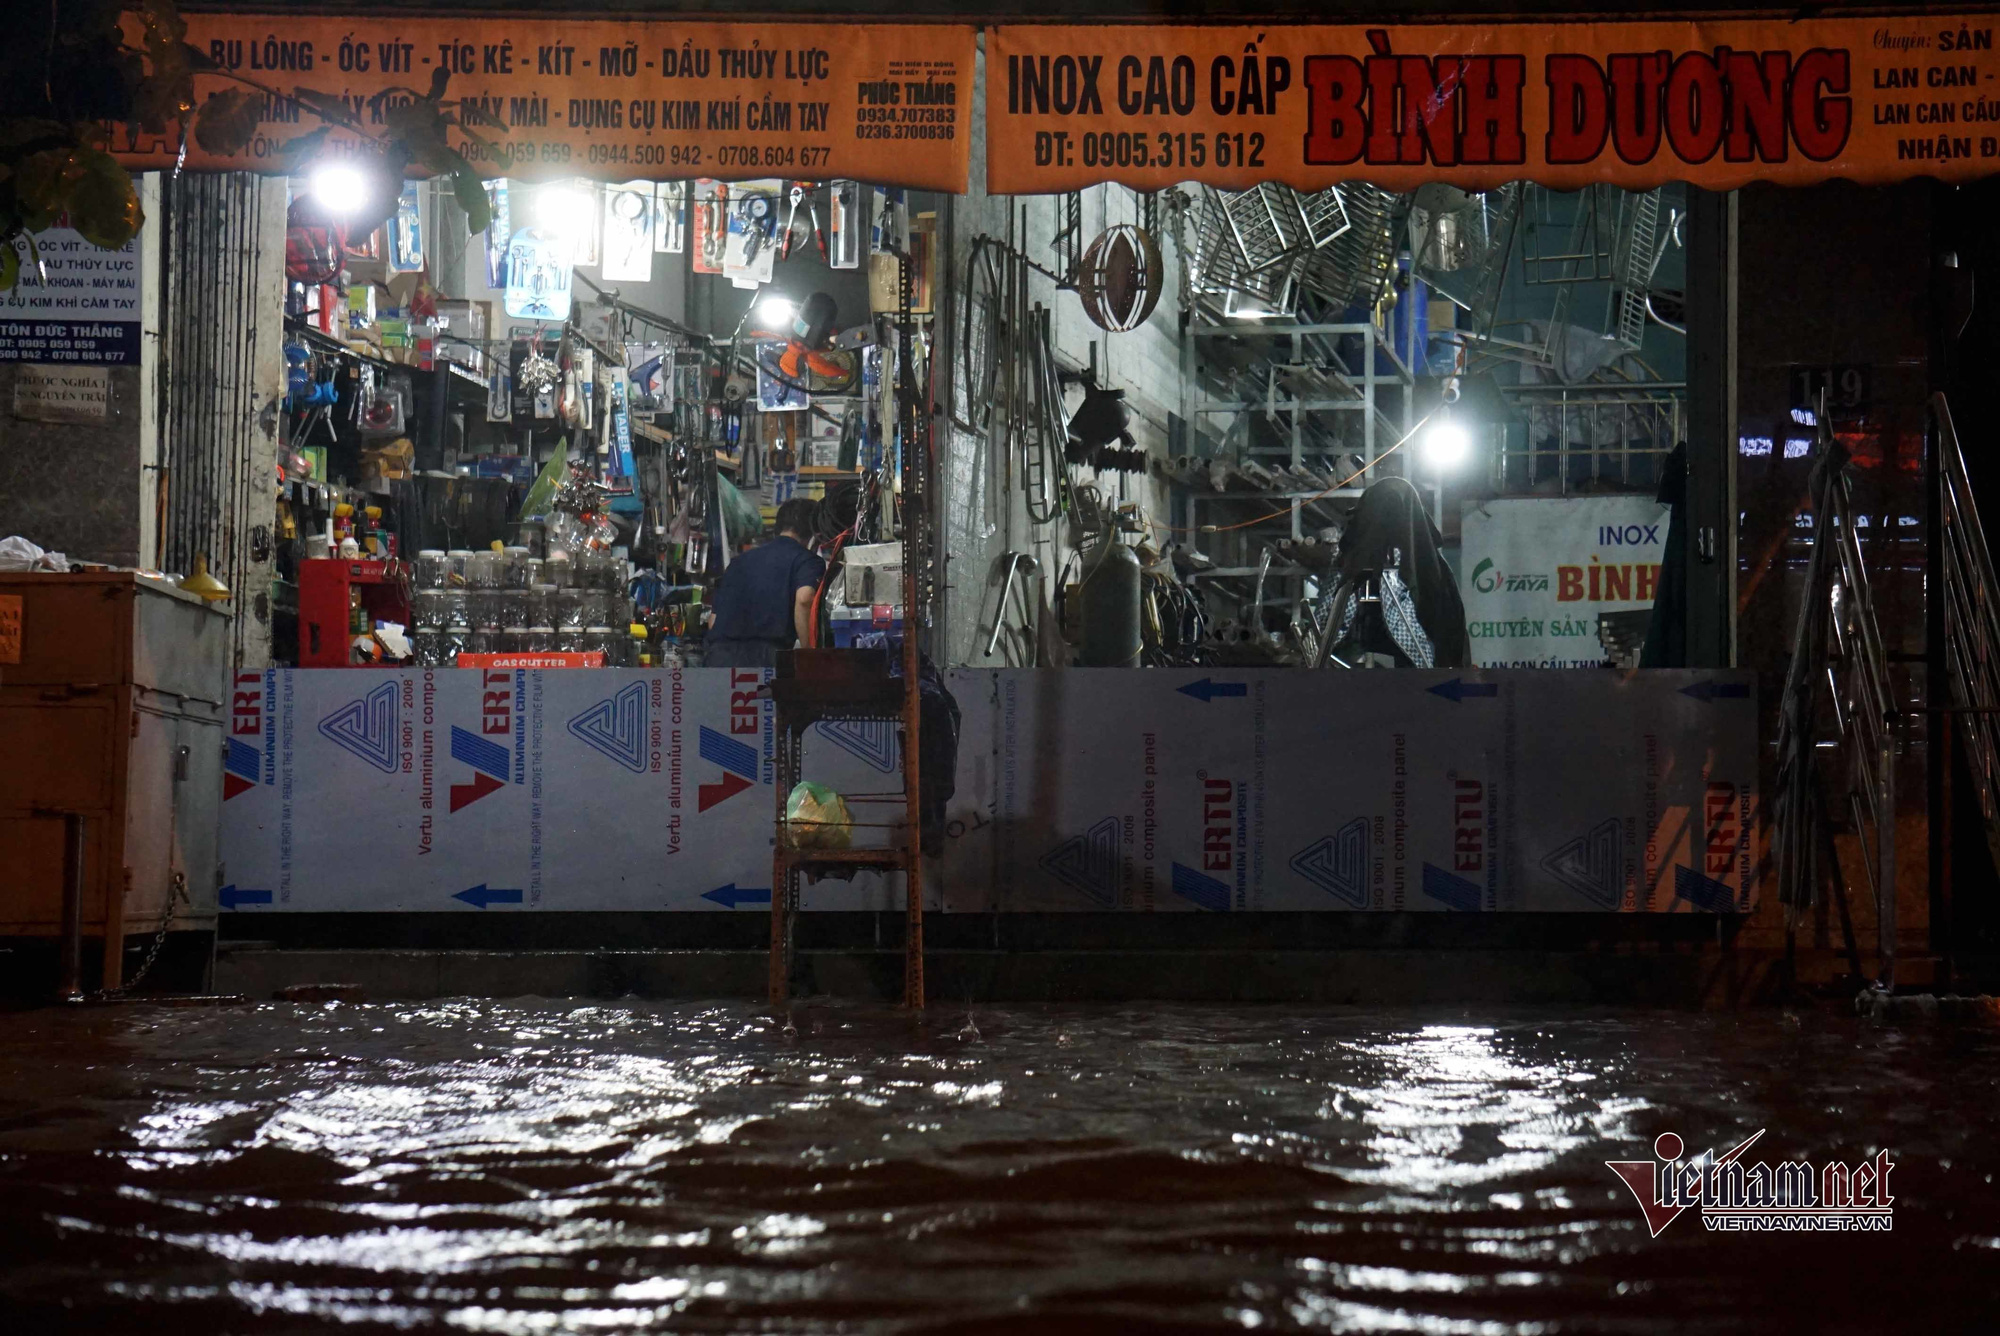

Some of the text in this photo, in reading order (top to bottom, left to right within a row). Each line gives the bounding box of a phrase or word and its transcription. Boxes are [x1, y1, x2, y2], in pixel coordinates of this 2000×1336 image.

[1938, 22, 1992, 51] SẢN
[251, 34, 313, 71] LÔNG
[338, 32, 370, 73] ỐC
[378, 37, 414, 73] VÍT
[438, 38, 475, 74] TÍC
[483, 39, 513, 74] KÊ
[538, 39, 575, 76] KÍT
[600, 40, 638, 77] MỠ
[662, 37, 710, 78] DẦU
[718, 39, 778, 79] THỦY
[785, 47, 830, 86] LỰC
[1008, 34, 1291, 116] INOX CAO CẤP
[1873, 66, 1977, 89] LAN CAN
[858, 78, 900, 105] PHÚC
[1304, 29, 1852, 167] BÌNH DƯƠNG
[510, 91, 548, 127] MÀI
[569, 97, 623, 135] DỤNG
[629, 100, 656, 136] CỤ
[662, 100, 700, 130] KIM
[707, 95, 740, 131] KHÍ
[746, 91, 791, 131] CẦM
[798, 102, 830, 132] TAY
[857, 108, 956, 123] 0934.707383
[1873, 102, 1956, 125] LAN CAN
[856, 124, 955, 140] 0236.3700836
[541, 143, 571, 163] 659
[588, 144, 665, 166] 0944.500
[670, 145, 701, 166] 942
[718, 146, 794, 167] 0708.604
[801, 147, 831, 167] 677
[1035, 132, 1265, 168] ĐT: 0905.315 612
[1898, 133, 2000, 164] NHẬN Đ
[47, 279, 84, 289] KHOAN
[29, 297, 52, 308] KIM
[113, 300, 135, 310] TAY
[0, 323, 30, 337] TÔN
[18, 339, 46, 348] 0905
[50, 340, 71, 349] 059
[21, 350, 41, 359] 942
[105, 352, 125, 361] 677
[1600, 525, 1659, 546] INOX
[1505, 579, 1549, 592] TAYA
[1557, 555, 1662, 602] BÌNH
[1469, 617, 1544, 638] CHUYÊN
[1550, 614, 1587, 637] SẢN
[281, 684, 292, 702] FILM
[531, 684, 542, 702] FILM
[1005, 679, 1016, 732] INSTALLATION
[281, 703, 292, 750] PROTECTIVE
[402, 679, 413, 774] ISO 9001 2008
[531, 703, 542, 749] PROTECTIVE
[651, 679, 662, 773] ISO 9001 2008
[264, 716, 276, 786] ALUMINIUM
[281, 751, 292, 766] THE
[515, 716, 525, 785] ALUMINIUM
[531, 751, 542, 766] THE
[1005, 735, 1016, 758] AFTER
[419, 730, 435, 809] aluminium
[531, 767, 542, 799] REMOVE
[668, 730, 684, 809] aluminium
[1143, 733, 1156, 861] composite panel
[1393, 733, 1407, 861] composite panel
[1237, 780, 1247, 848] COMPOSITE
[1644, 780, 1658, 862] composite
[281, 822, 292, 845] RIGHT
[419, 815, 435, 855] Vertu
[531, 821, 542, 844] RIGHT
[668, 815, 684, 855] Vertu
[1123, 815, 1133, 845] 2008
[281, 846, 292, 861] THE
[531, 845, 542, 860] THE
[531, 861, 542, 870] IN
[1374, 815, 1384, 910] ISO 9001 2008
